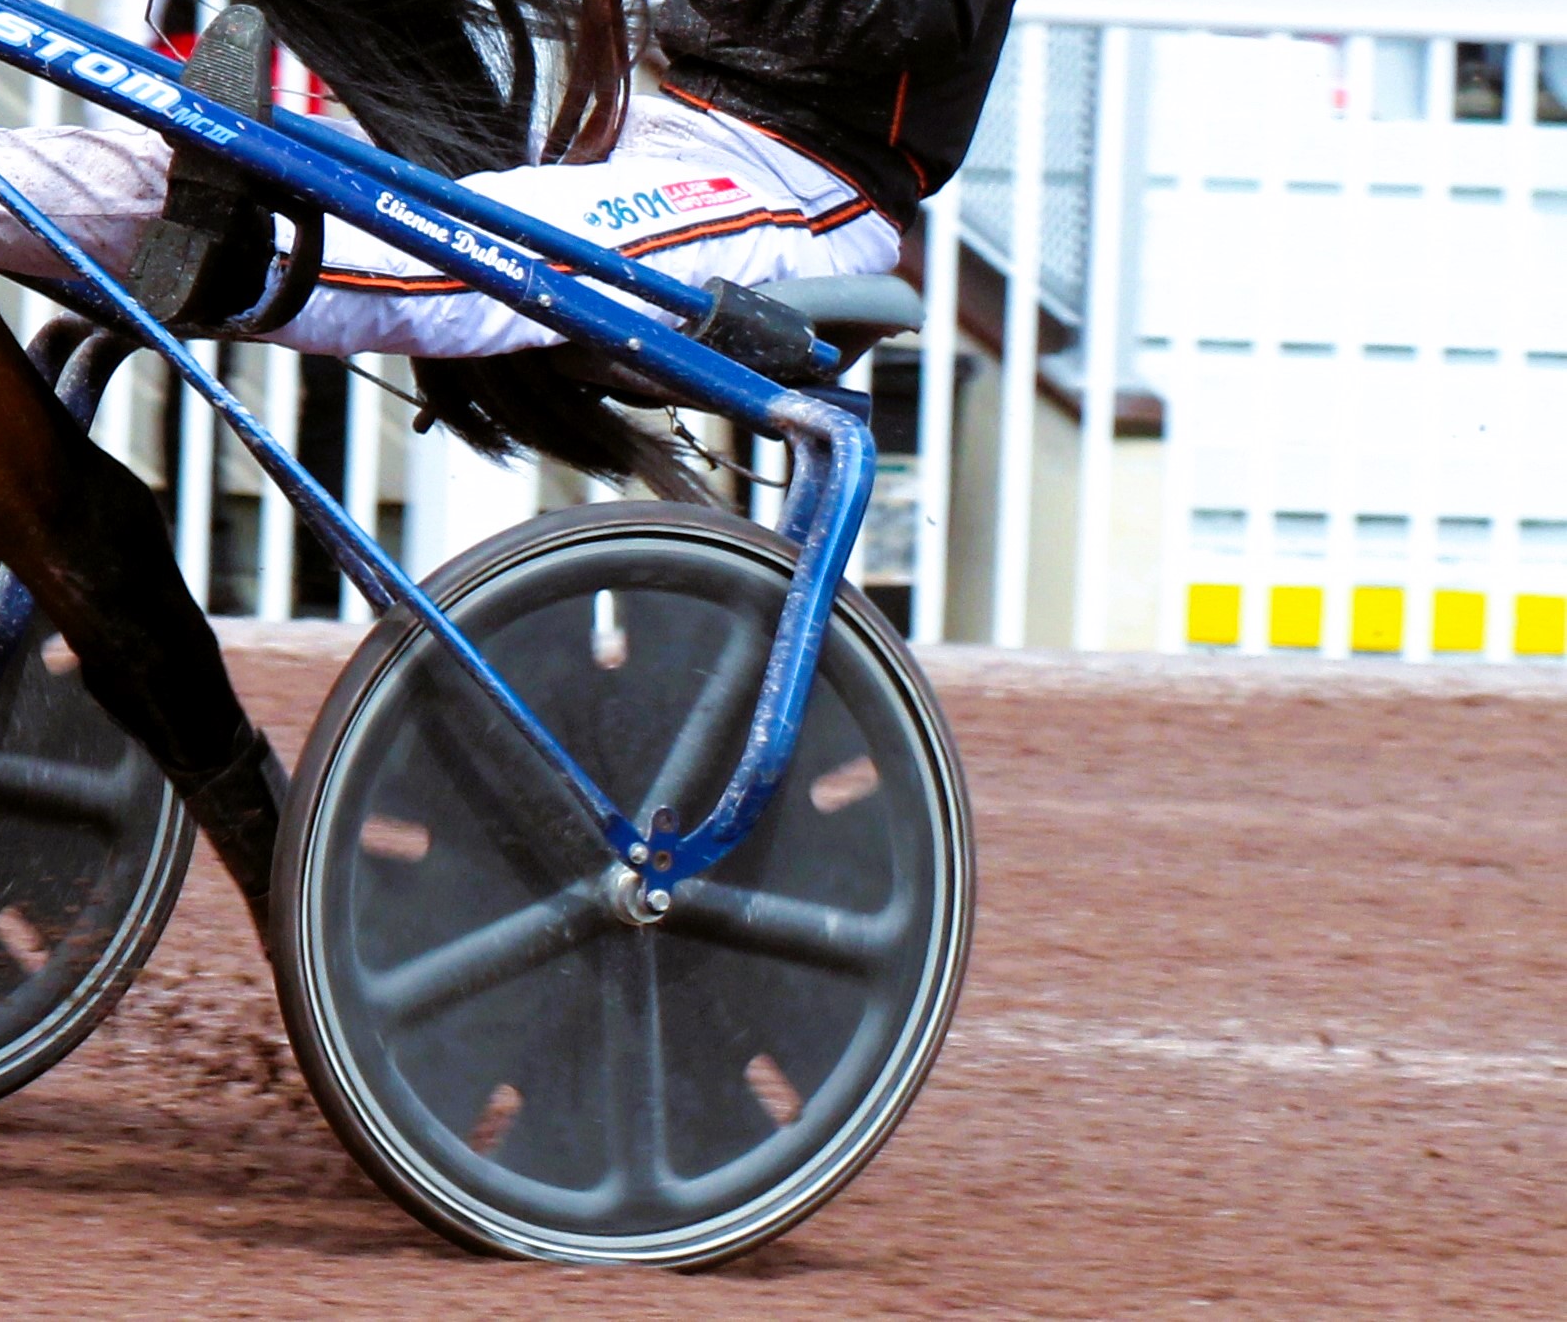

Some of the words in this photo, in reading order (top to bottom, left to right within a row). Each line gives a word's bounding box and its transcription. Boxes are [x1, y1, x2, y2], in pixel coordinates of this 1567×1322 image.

[375, 190, 450, 244] Etienne
[450, 229, 526, 281] Dubois
[596, 196, 640, 230] 36
[632, 187, 678, 219] 01
